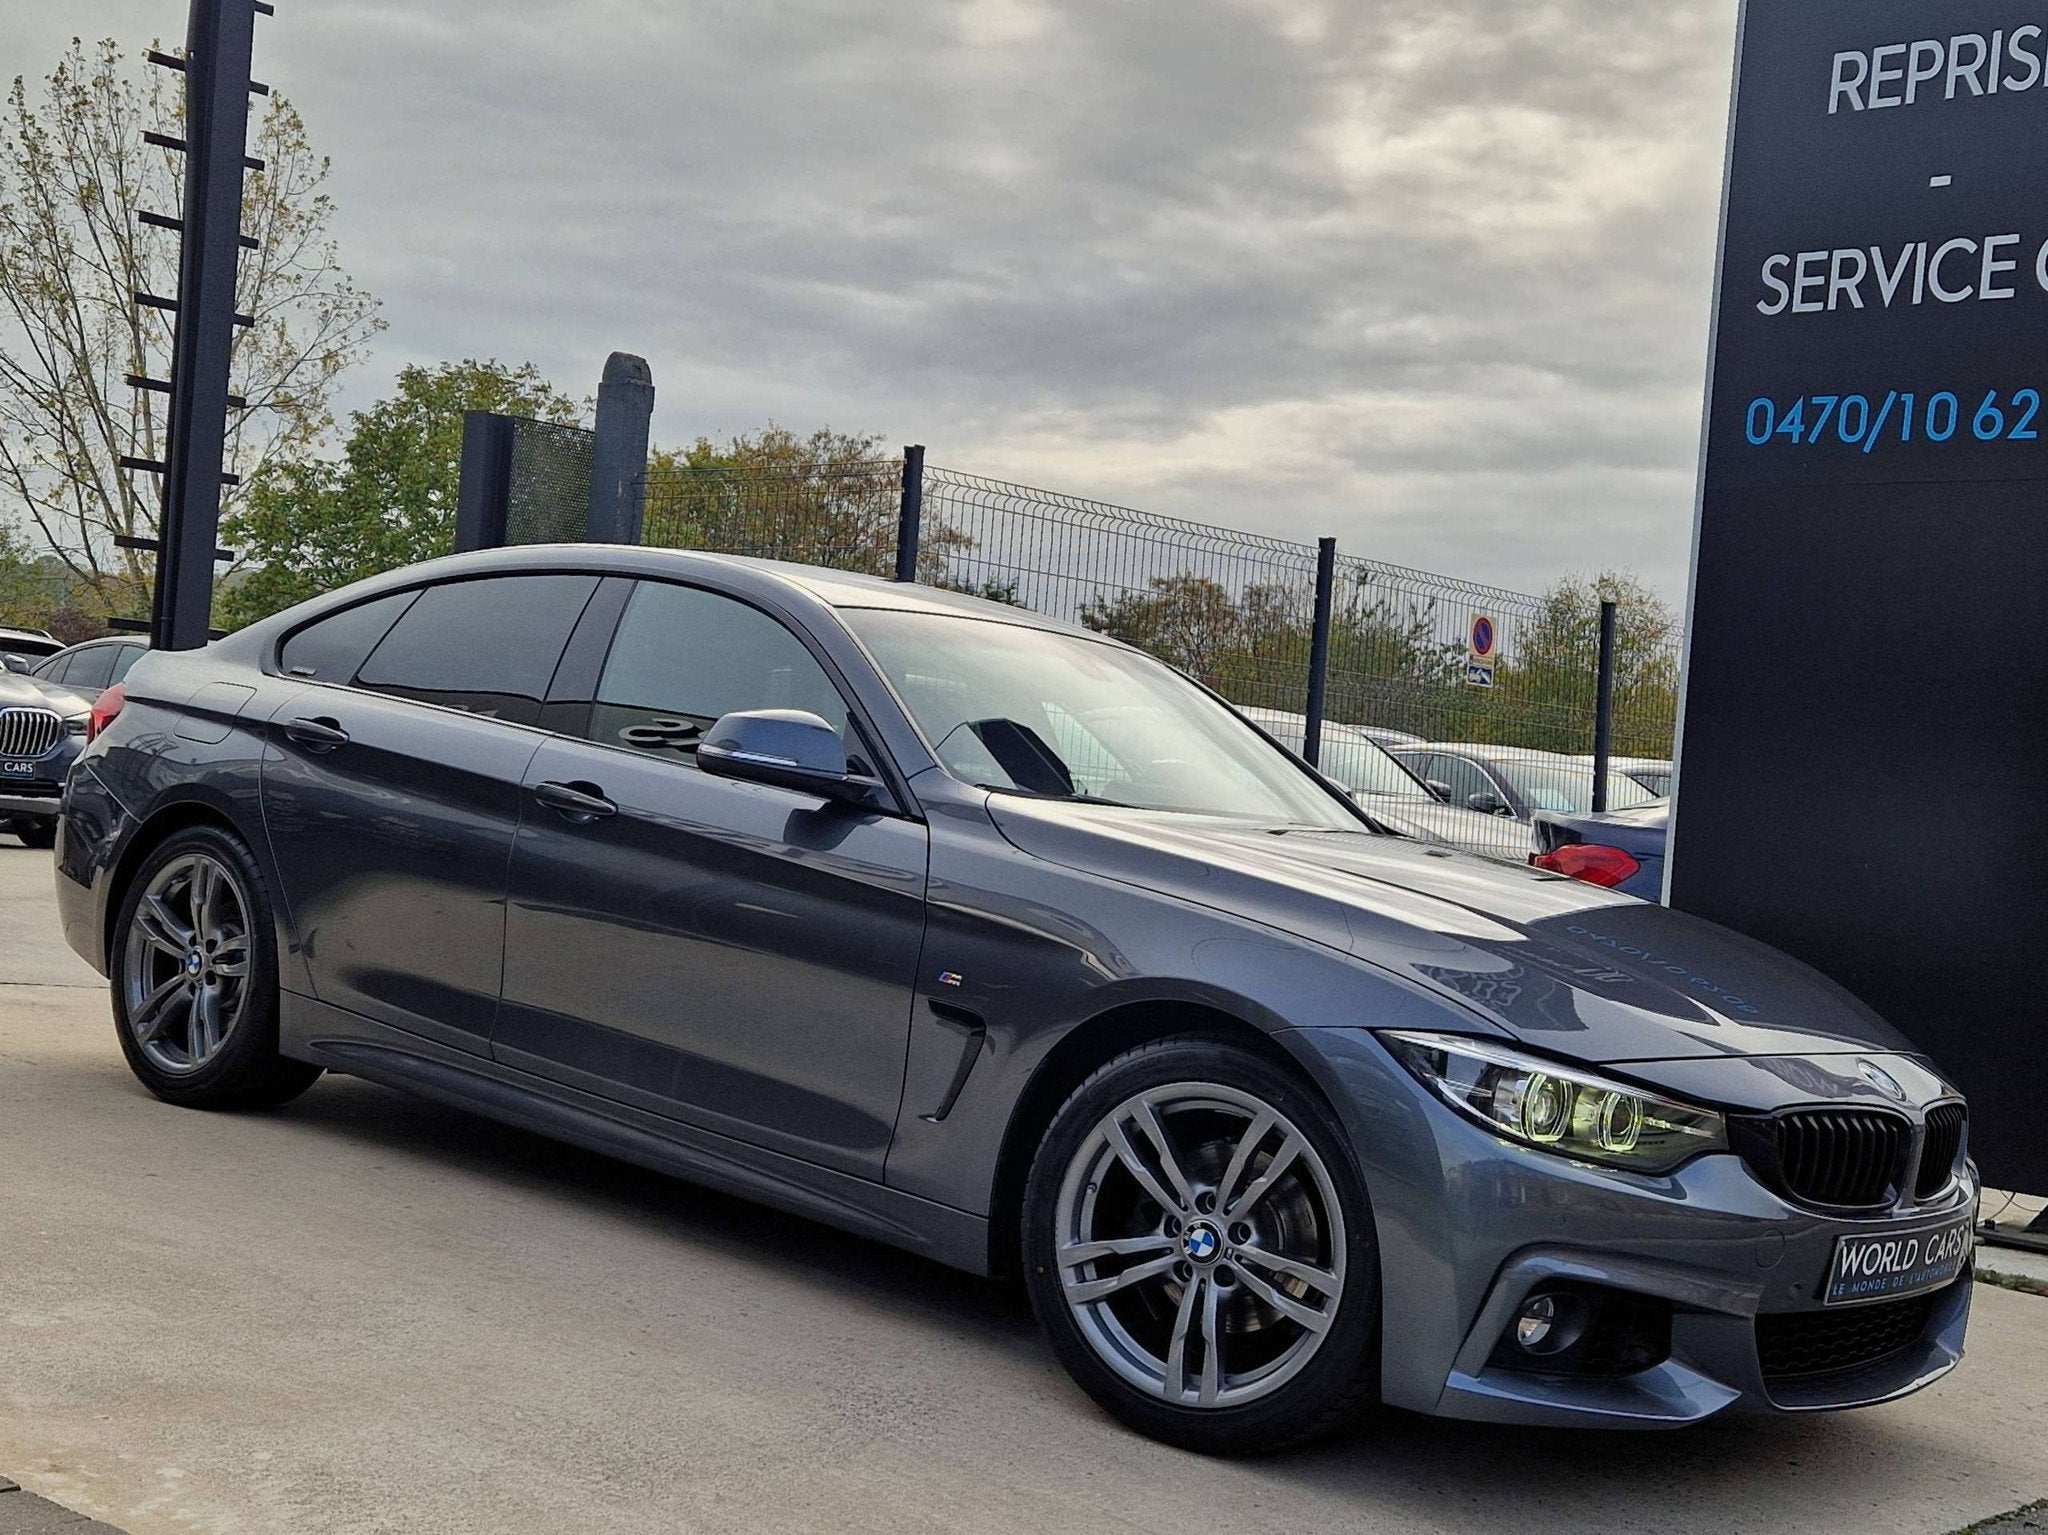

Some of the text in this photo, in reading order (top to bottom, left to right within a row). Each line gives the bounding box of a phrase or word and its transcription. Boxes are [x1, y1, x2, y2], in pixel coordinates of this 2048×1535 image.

[1828, 25, 2048, 114] REPRIS
[1756, 234, 2020, 315] SERVICE
[1745, 388, 2040, 454] 0470/10 62
[4, 762, 33, 772] CARS
[1841, 1226, 1963, 1278] WORLD CARS
[1832, 1283, 1846, 1296] LE
[1851, 1279, 1887, 1294] MONDE
[1892, 1276, 1905, 1288] DE
